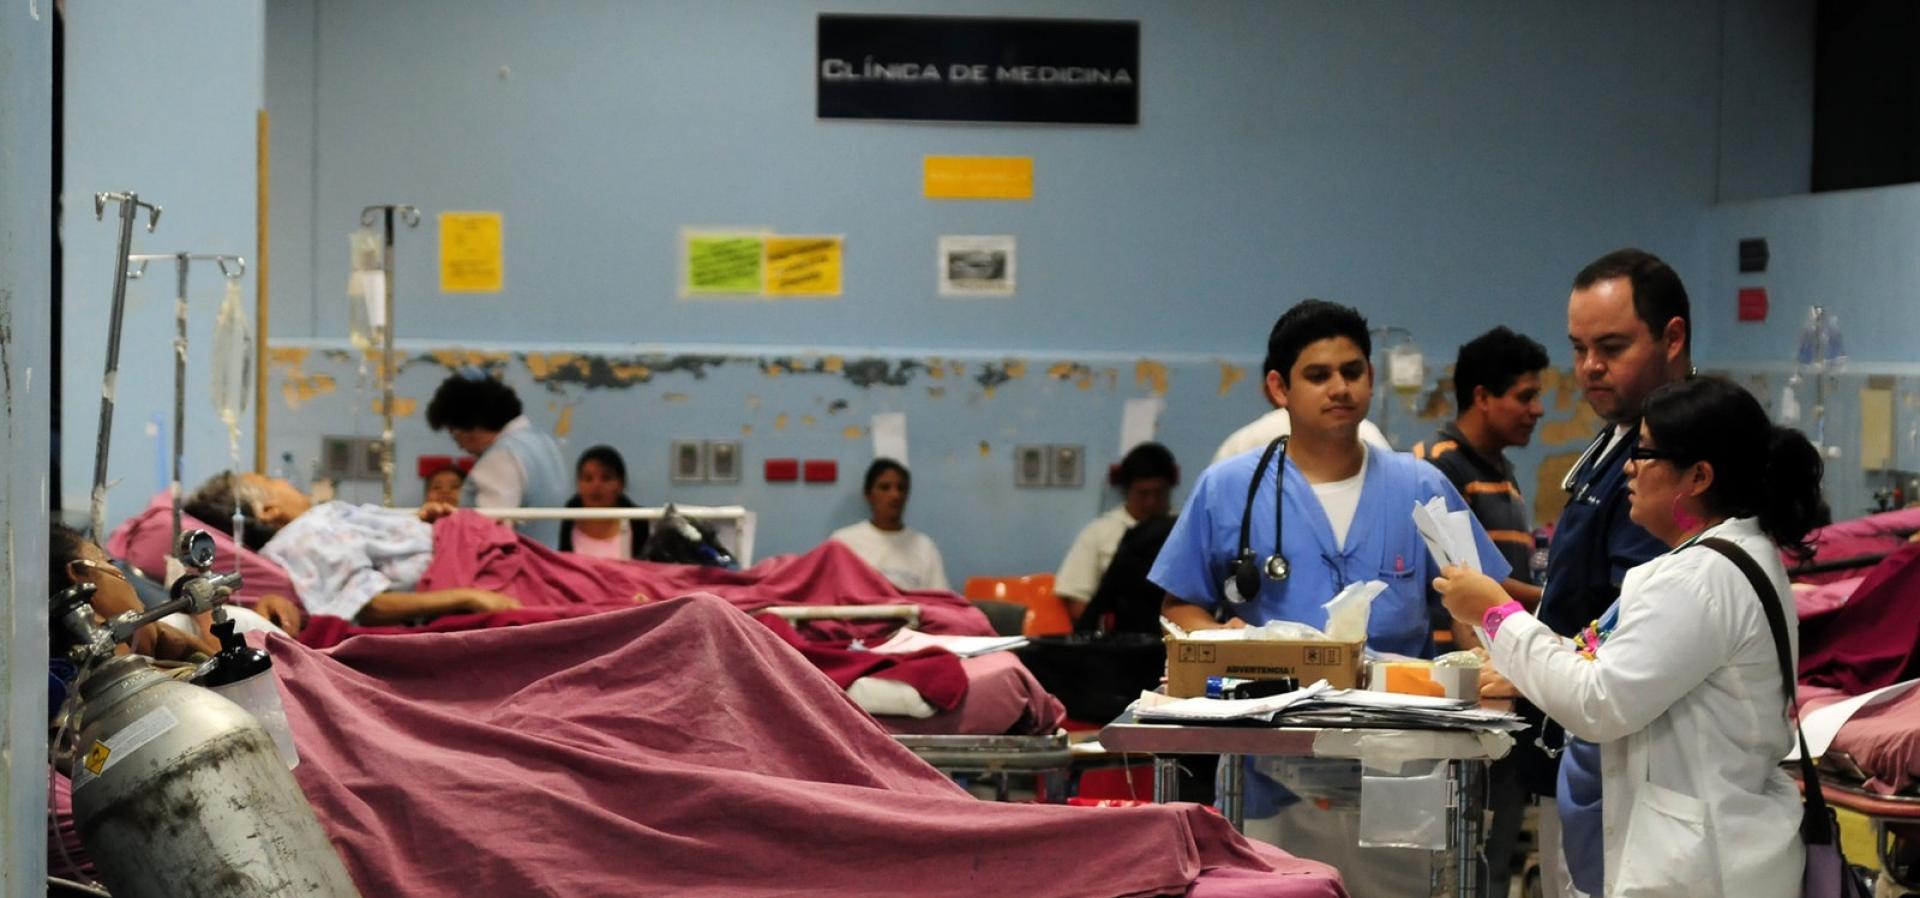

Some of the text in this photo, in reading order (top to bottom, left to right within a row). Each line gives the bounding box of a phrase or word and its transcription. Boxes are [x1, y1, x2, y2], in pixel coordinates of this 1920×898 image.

[822, 56, 1132, 83] CLÍNICA DE MEDICINA
